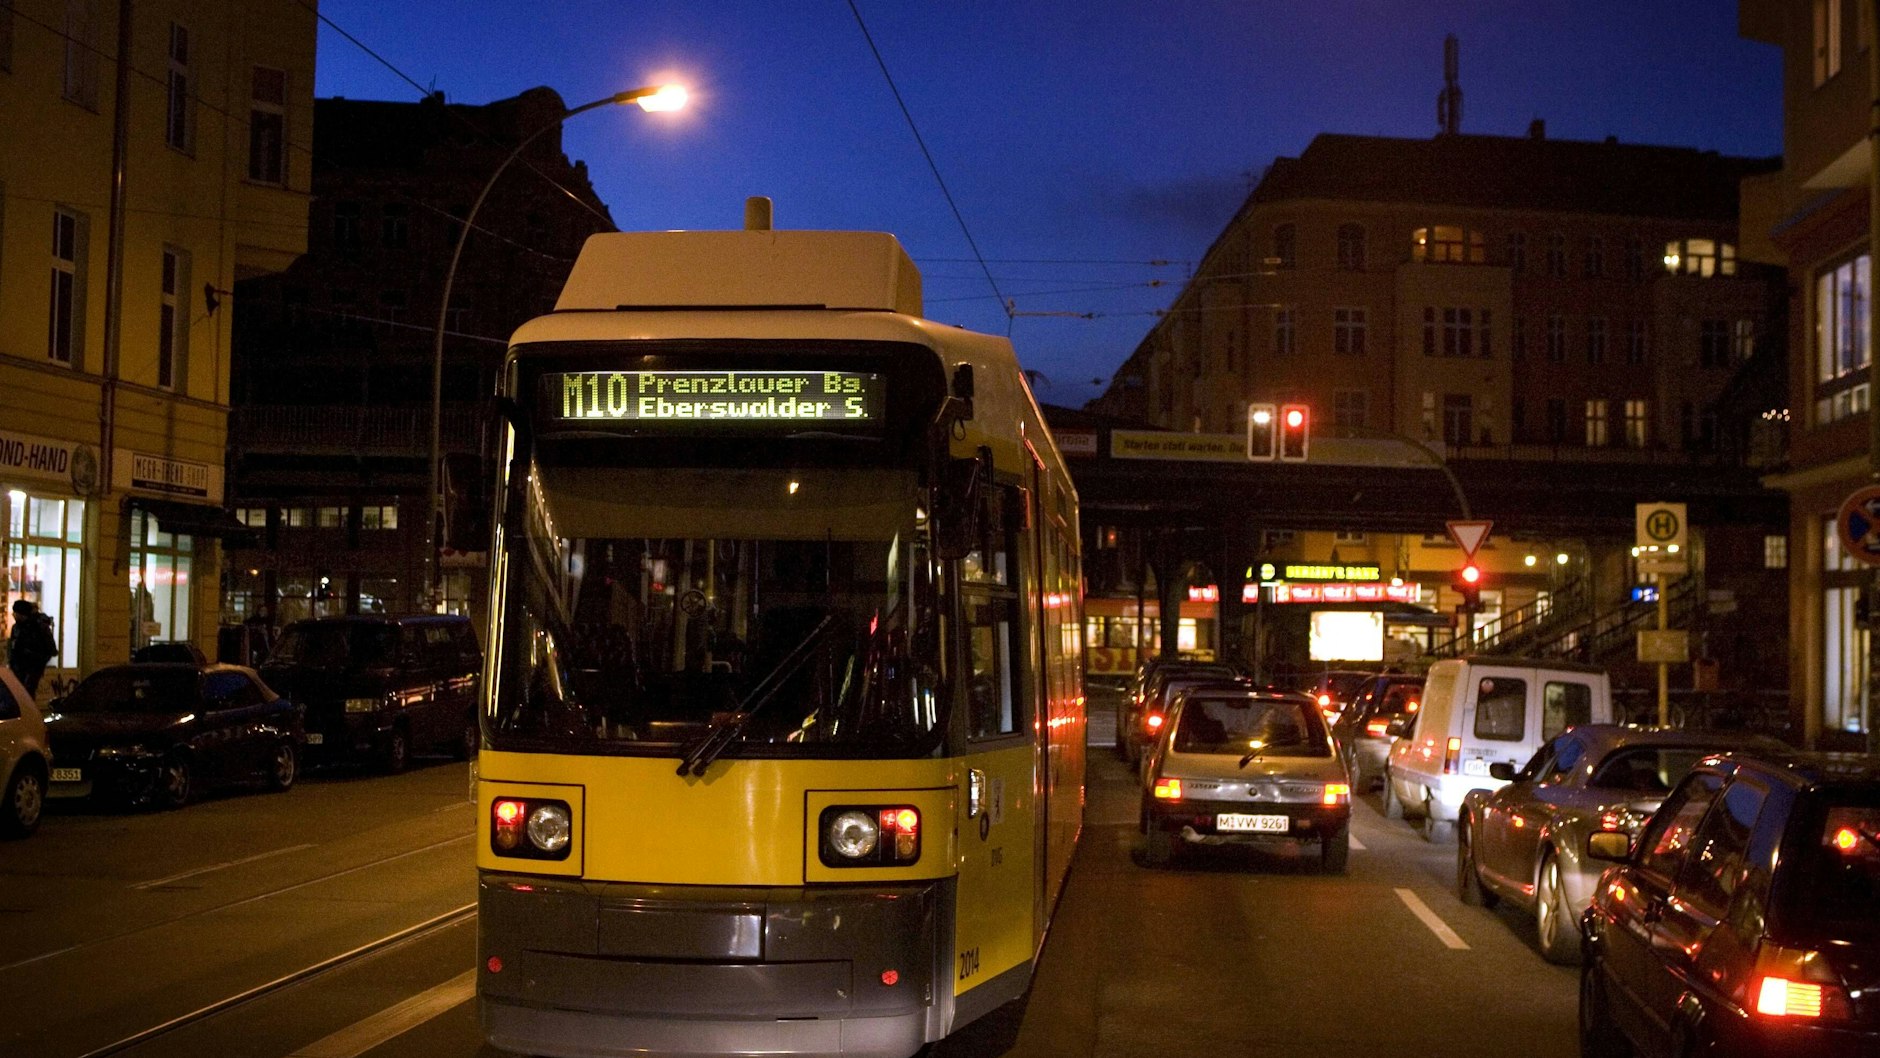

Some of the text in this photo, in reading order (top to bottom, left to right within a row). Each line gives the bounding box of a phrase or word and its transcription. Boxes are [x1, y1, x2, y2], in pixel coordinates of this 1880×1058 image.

[638, 373, 866, 394] Prenzlauer Bg.
[563, 373, 627, 417] M10
[638, 397, 869, 418] Eberswalder S.
[56, 769, 79, 780] 8351
[1219, 817, 1287, 830] M VW 9261
[959, 947, 980, 981] 2014
